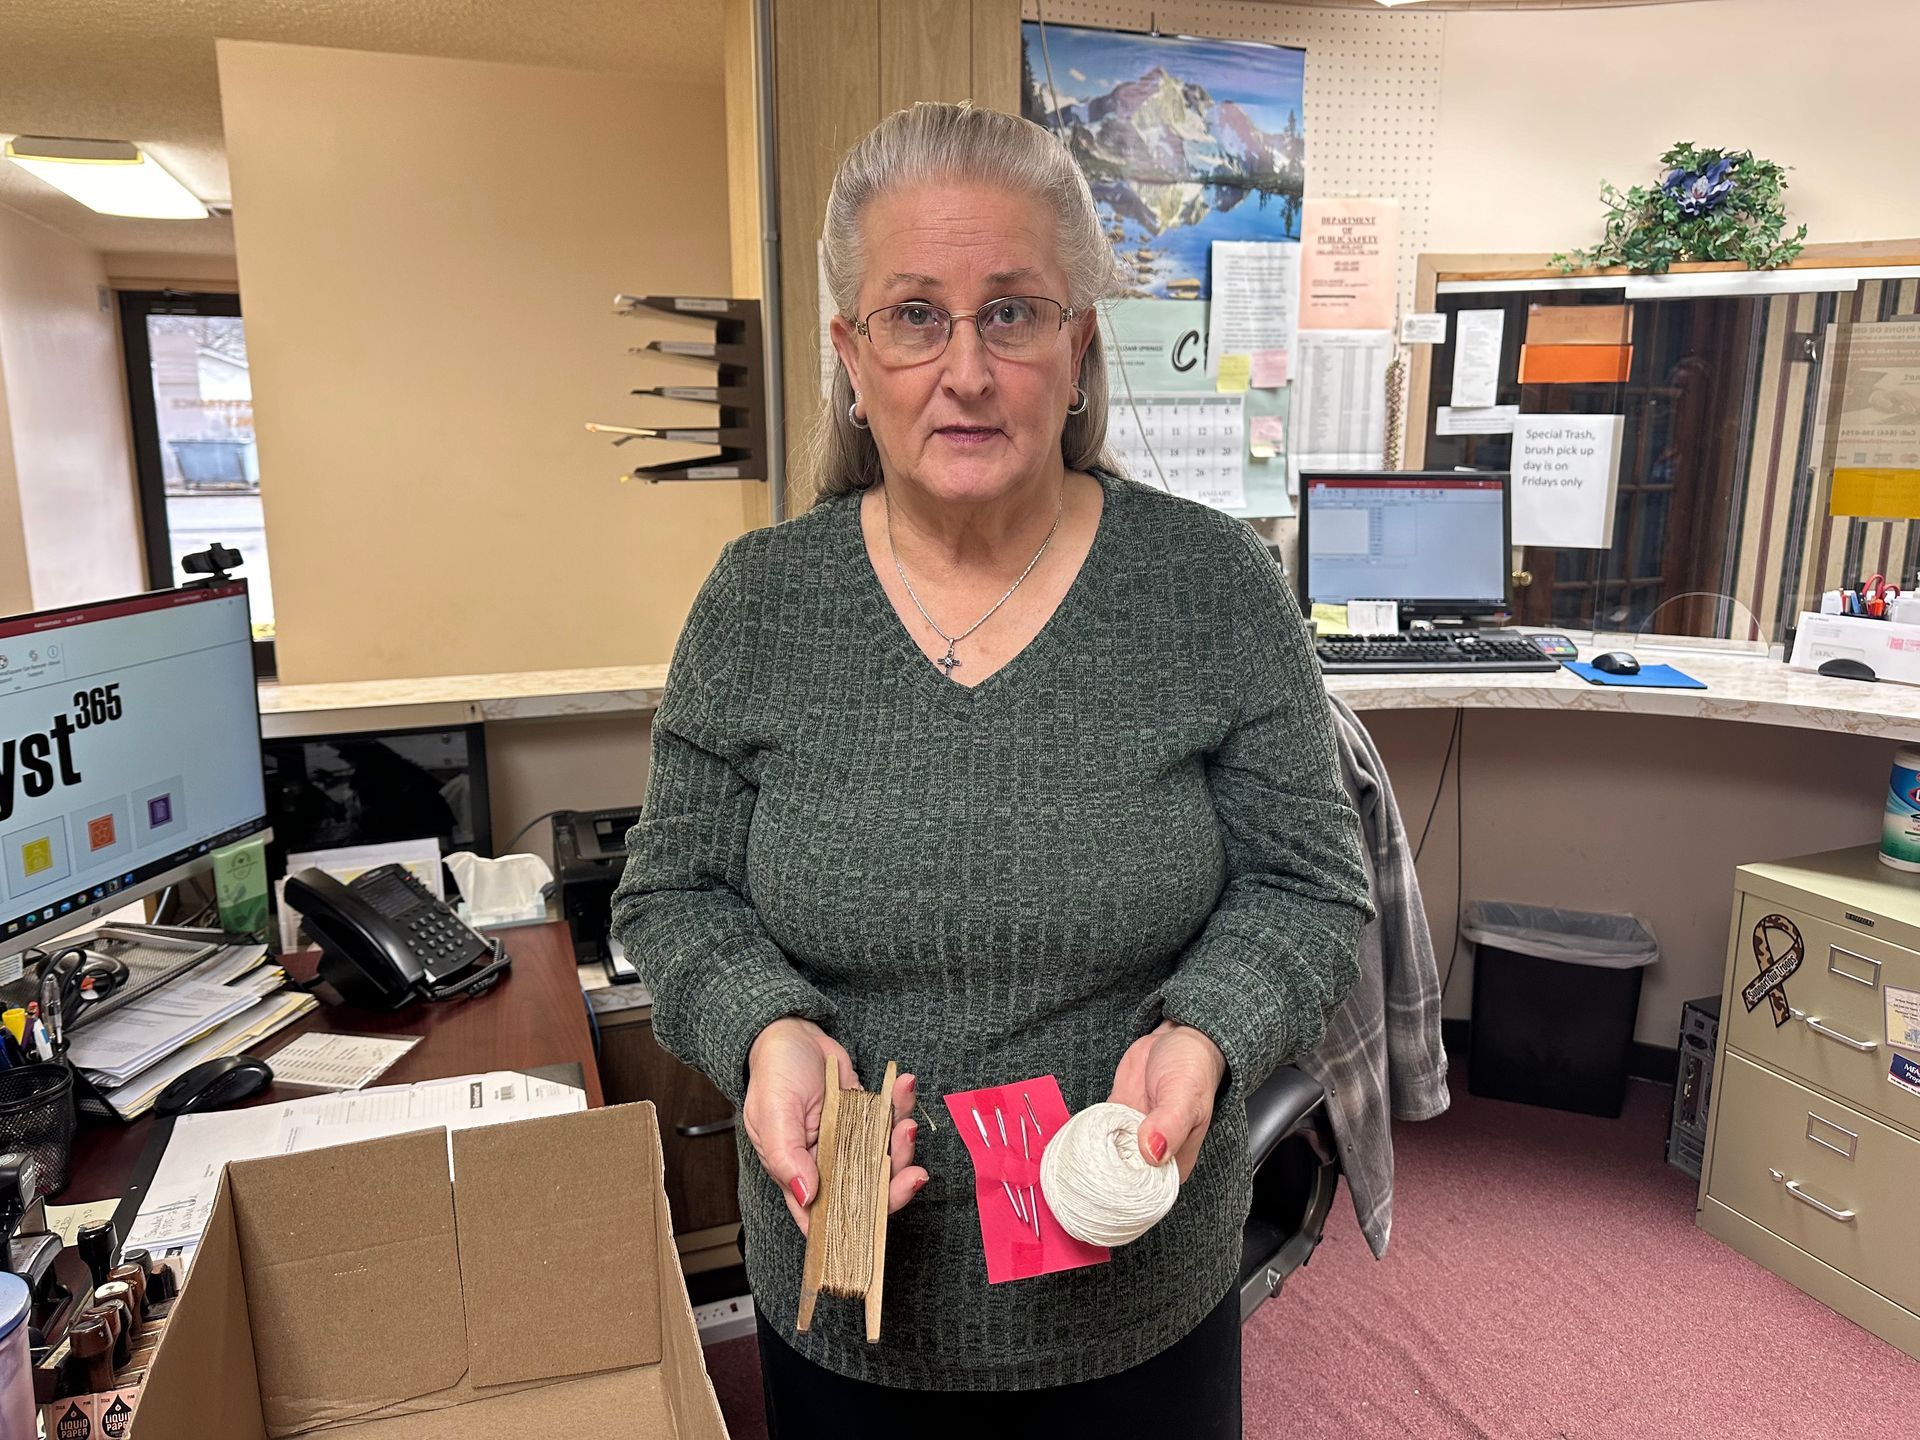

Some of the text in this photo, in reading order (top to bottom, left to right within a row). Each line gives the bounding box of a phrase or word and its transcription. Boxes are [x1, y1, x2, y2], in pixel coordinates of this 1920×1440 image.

[1321, 216, 1376, 225] DEPARTMENT
[1317, 236, 1378, 244] PUBLIC SAFETY
[1145, 428, 1154, 436] 10
[1172, 428, 1180, 436] 11
[1198, 427, 1207, 436] 12
[1224, 427, 1232, 435] 13
[1525, 429, 1596, 440] Special Trash,
[1170, 448, 1179, 456] 18
[1196, 448, 1205, 456] 19
[1222, 448, 1231, 456] 20
[1524, 445, 1594, 457] brush pick up
[1523, 461, 1541, 471] day
[1544, 461, 1552, 470] is
[1170, 469, 1178, 477] 25
[1196, 469, 1204, 477] 26
[1222, 468, 1231, 476] 27
[1521, 476, 1583, 488] Fridays only
[73, 683, 122, 729] 365
[1746, 976, 1770, 1000] Support
[1775, 954, 1798, 976] Troops
[60, 1418, 88, 1431] LIQUID
[61, 1428, 88, 1438] PAPER
